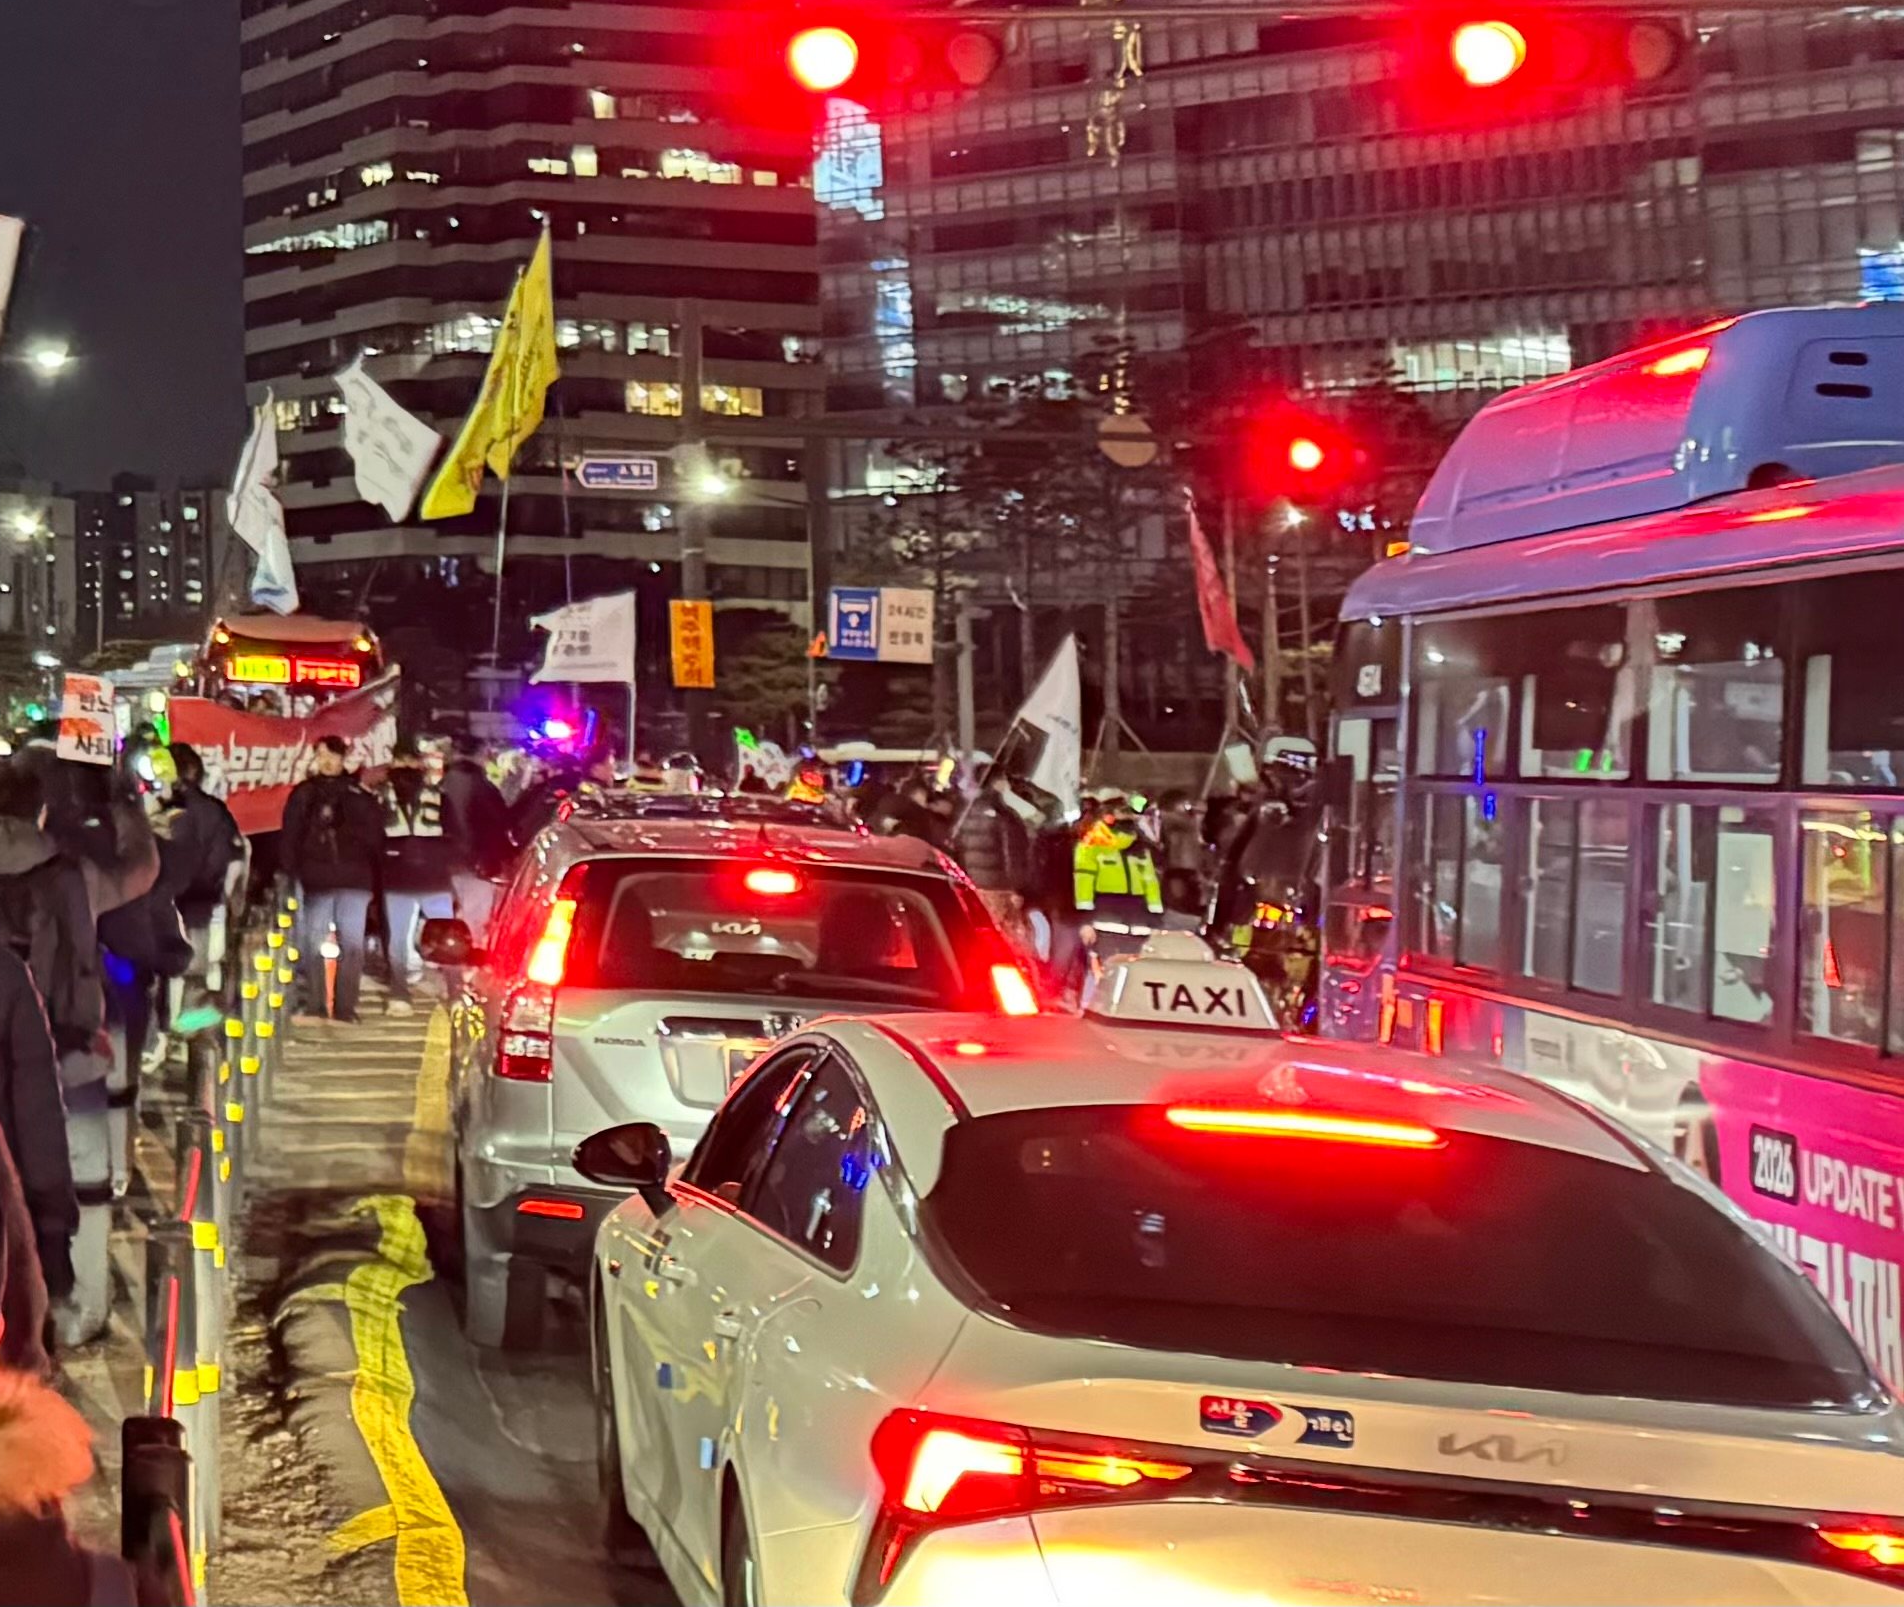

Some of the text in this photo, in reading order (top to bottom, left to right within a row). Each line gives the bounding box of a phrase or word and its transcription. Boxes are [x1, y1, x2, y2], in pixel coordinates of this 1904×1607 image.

[1143, 980, 1248, 1019] TAXI
[593, 1036, 647, 1048] HONDA
[1752, 1134, 1897, 1230] 2026 UPDATE
